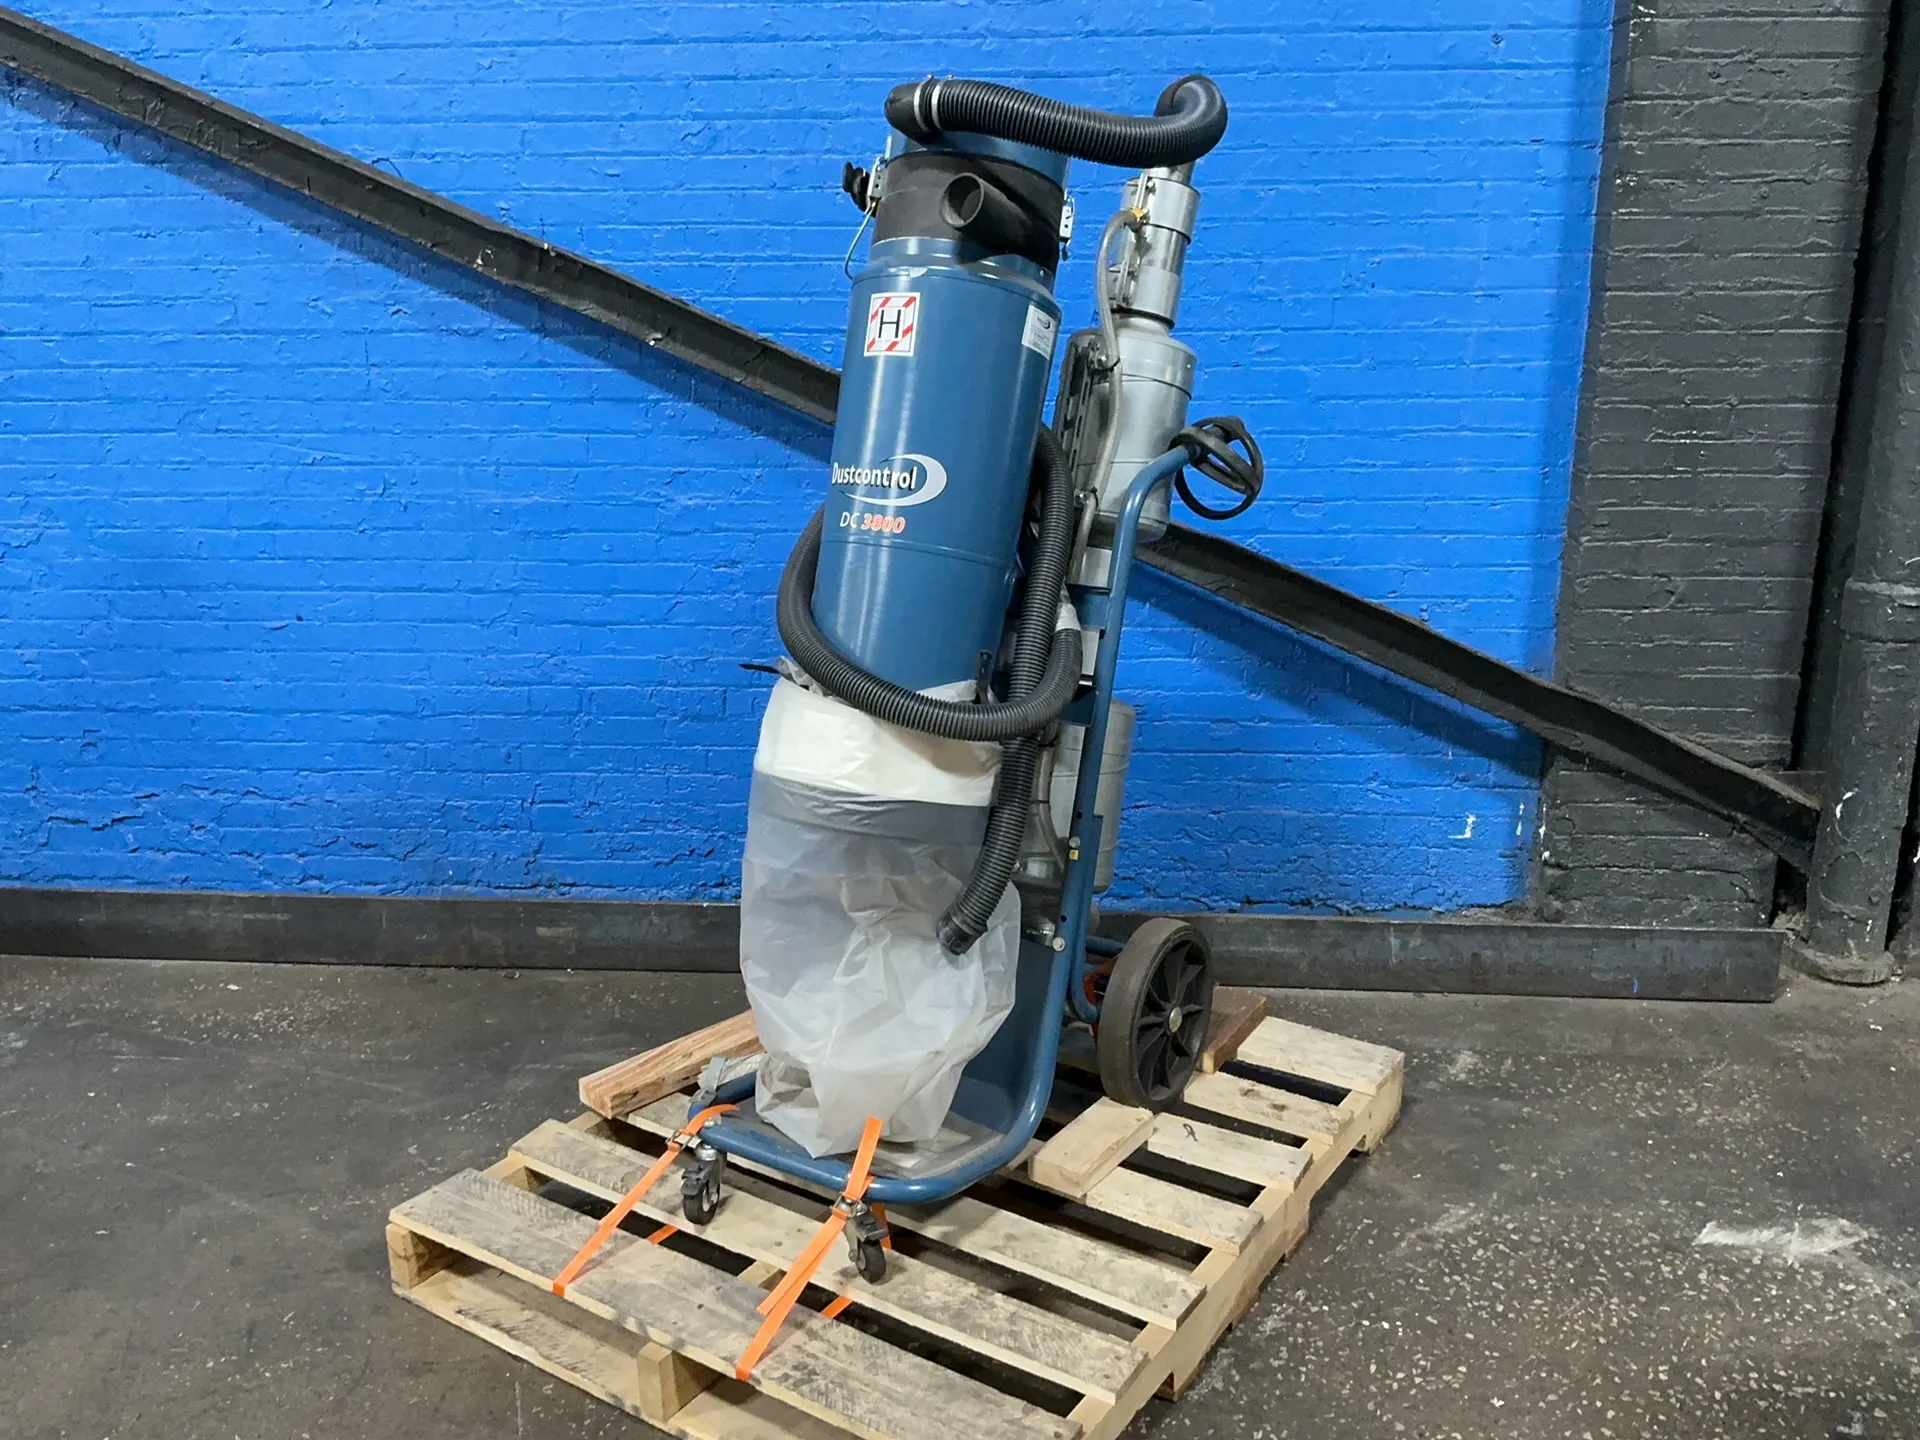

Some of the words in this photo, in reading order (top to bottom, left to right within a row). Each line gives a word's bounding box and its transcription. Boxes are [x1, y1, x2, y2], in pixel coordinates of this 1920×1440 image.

[878, 309, 901, 339] H
[832, 462, 917, 490] Dustcontrol
[840, 511, 860, 528] DC
[861, 513, 905, 533] 3800
